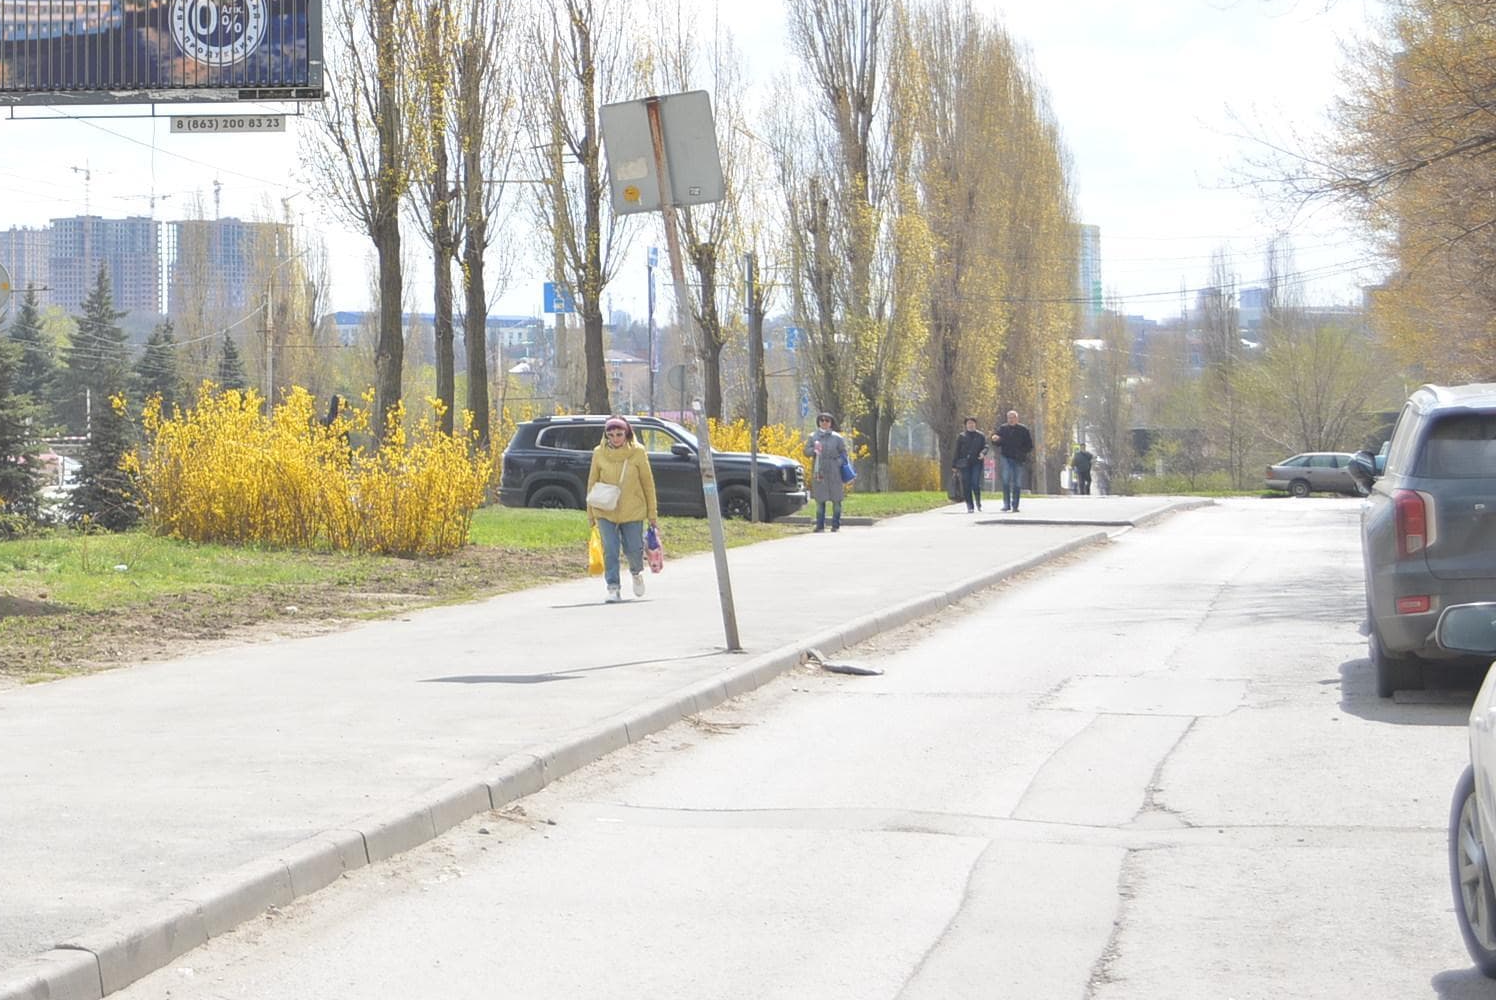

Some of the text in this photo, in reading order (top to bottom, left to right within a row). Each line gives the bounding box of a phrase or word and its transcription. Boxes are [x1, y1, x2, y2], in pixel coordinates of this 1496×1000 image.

[176, 118, 280, 131] 8 (863) 200 83 23
